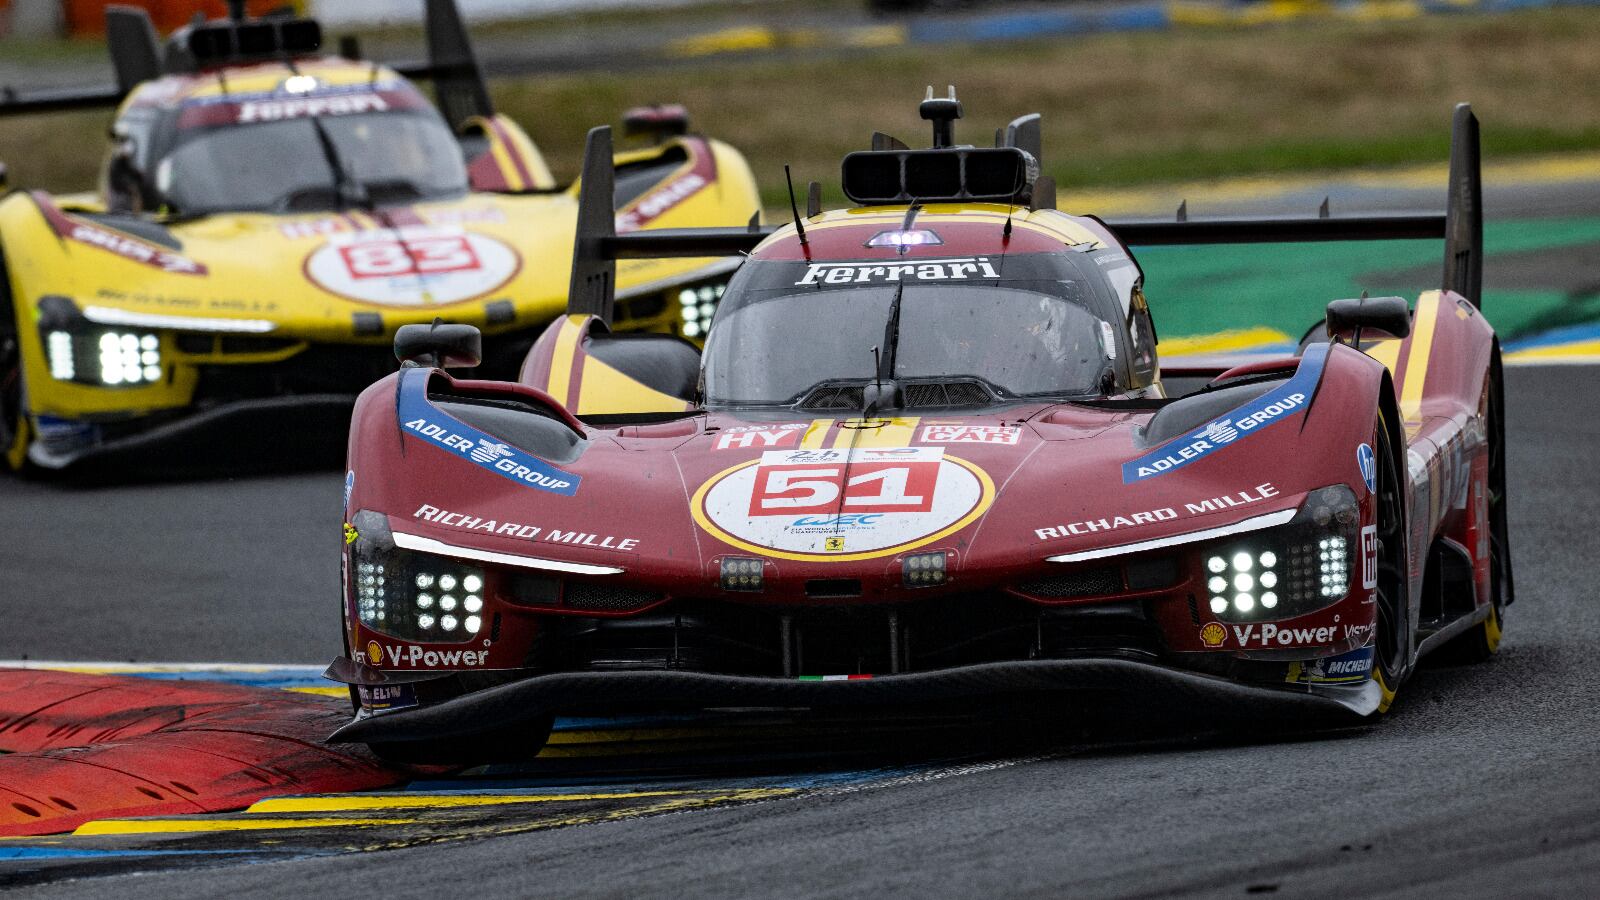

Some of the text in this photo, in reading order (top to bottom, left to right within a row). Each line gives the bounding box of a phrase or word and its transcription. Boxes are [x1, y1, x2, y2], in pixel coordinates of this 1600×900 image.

[350, 240, 472, 274] 83
[795, 257, 1002, 286] Ferrari
[717, 430, 795, 449] HY
[927, 431, 1012, 442] CAR
[929, 426, 1015, 434] HYPER
[1137, 393, 1305, 477] ADLER GROUP
[405, 418, 570, 491] ADLER GROUP
[762, 467, 923, 508] 51
[793, 513, 884, 526] WEC
[1034, 483, 1280, 540] RICHARD MILLE
[414, 503, 641, 552] RICHARD MILLE
[1233, 623, 1338, 647] V-Power
[386, 645, 489, 666] V-Power
[1328, 658, 1372, 674] MICHELIN
